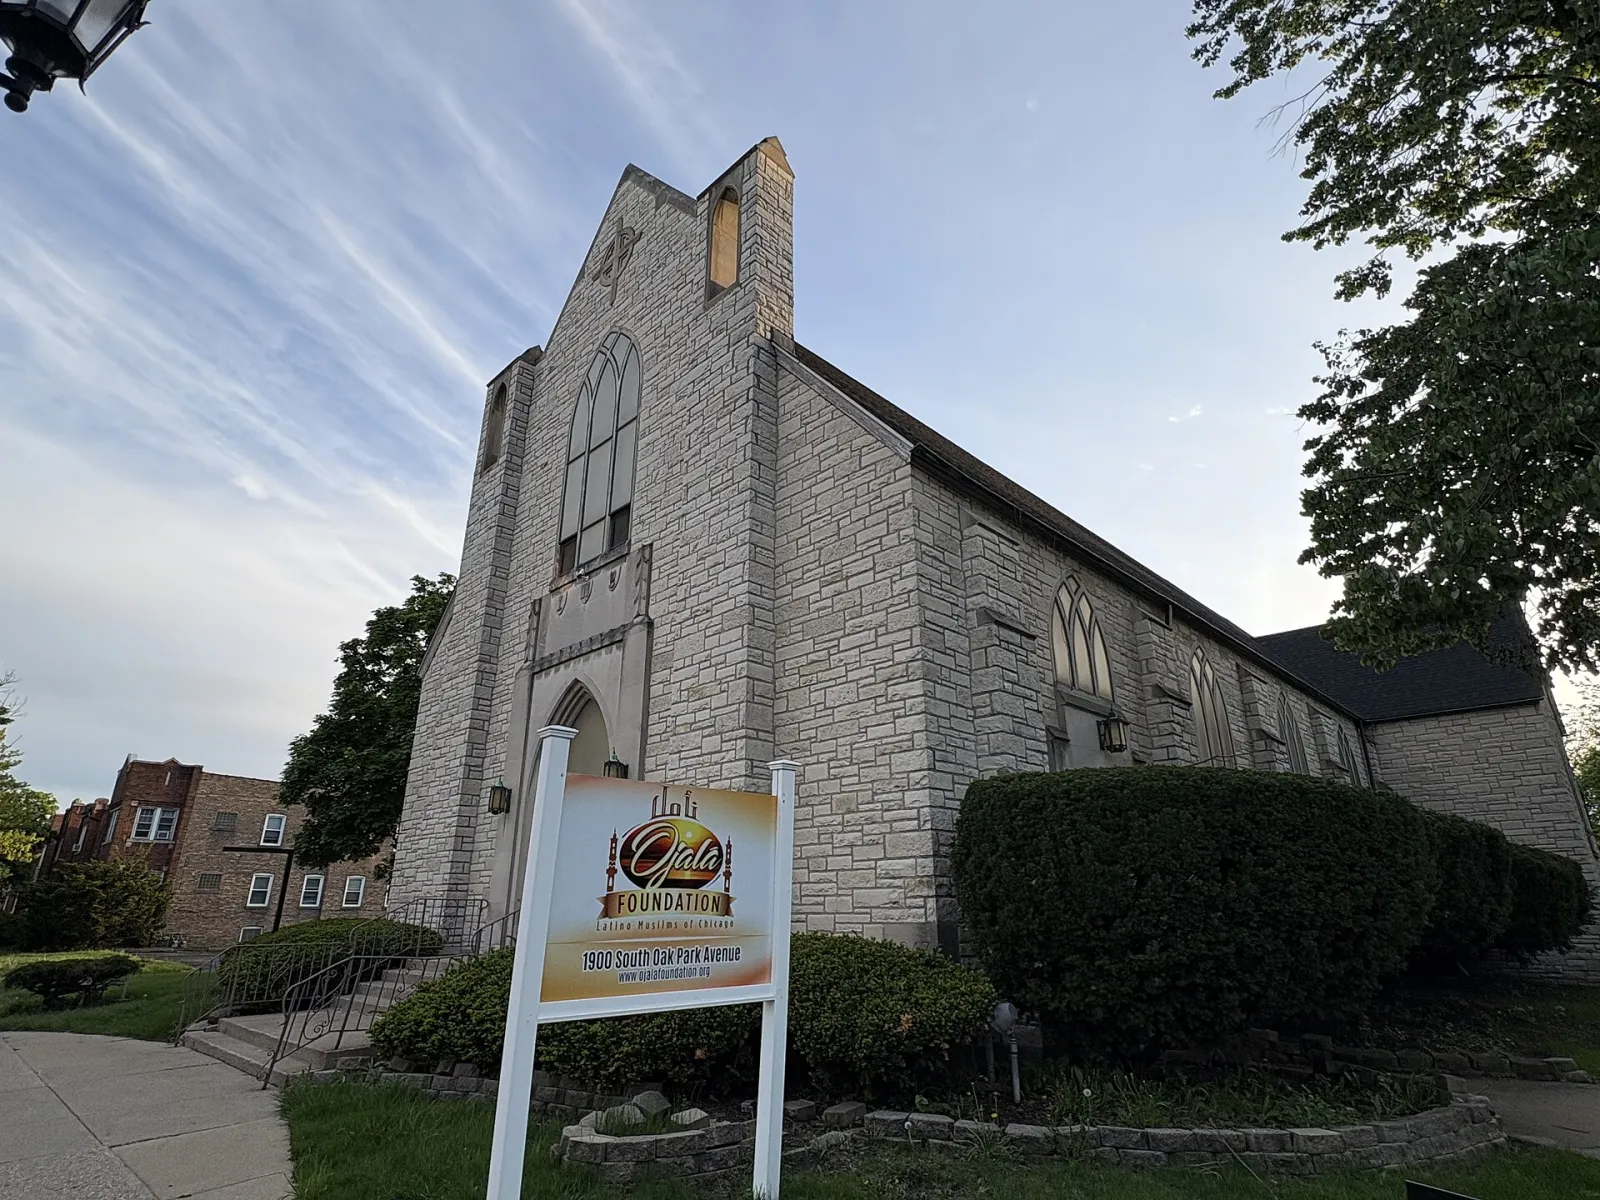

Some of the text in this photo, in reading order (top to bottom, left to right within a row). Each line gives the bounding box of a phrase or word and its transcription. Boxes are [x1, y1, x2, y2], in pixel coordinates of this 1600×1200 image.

[617, 892, 721, 914] FOUNDATION
[596, 919, 734, 931] Latino Muslims of Chicago
[583, 946, 741, 970] 1900 South Oak Park Avenue
